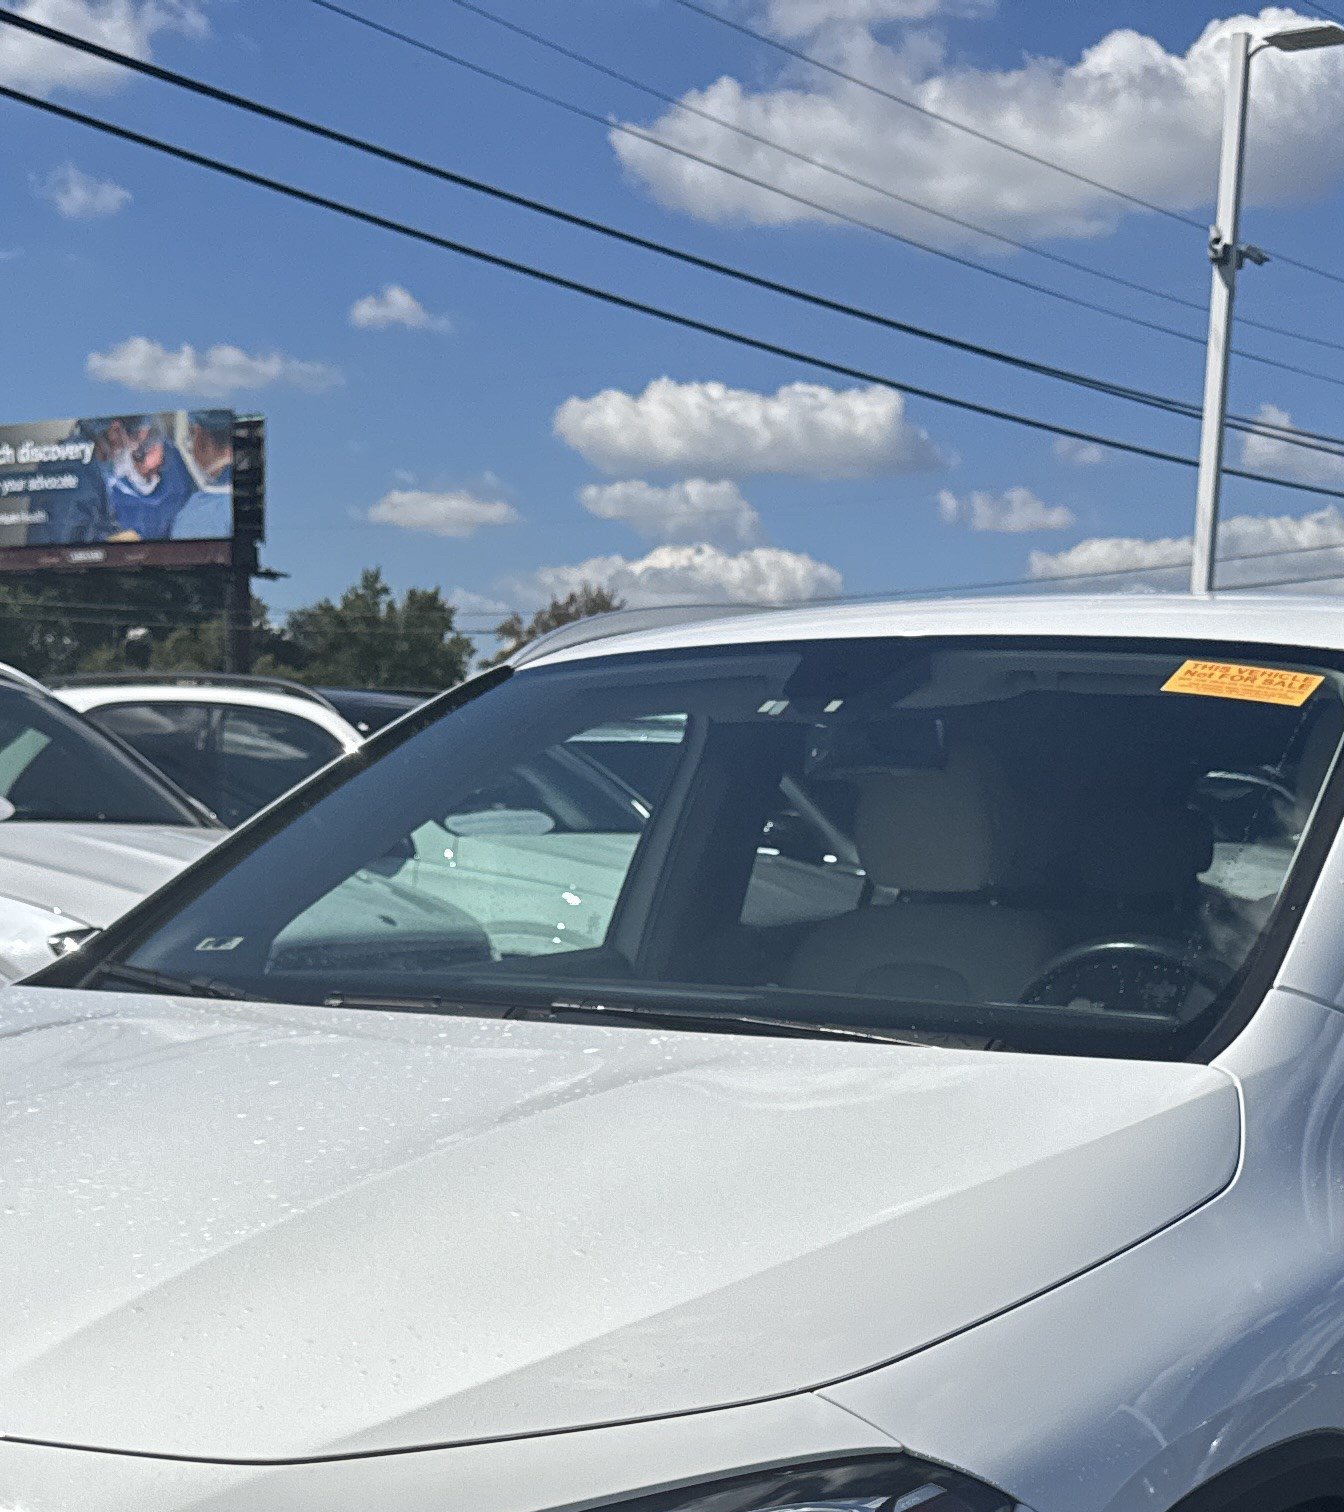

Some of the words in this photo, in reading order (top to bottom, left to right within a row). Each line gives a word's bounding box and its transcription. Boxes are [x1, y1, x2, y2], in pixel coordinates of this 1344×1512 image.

[16, 440, 95, 465] discovery
[27, 474, 78, 492] advocate
[1191, 662, 1232, 674] THIS
[1236, 667, 1316, 683] VEHICLE
[1218, 672, 1257, 684] FOR
[1262, 678, 1311, 690] SALE
